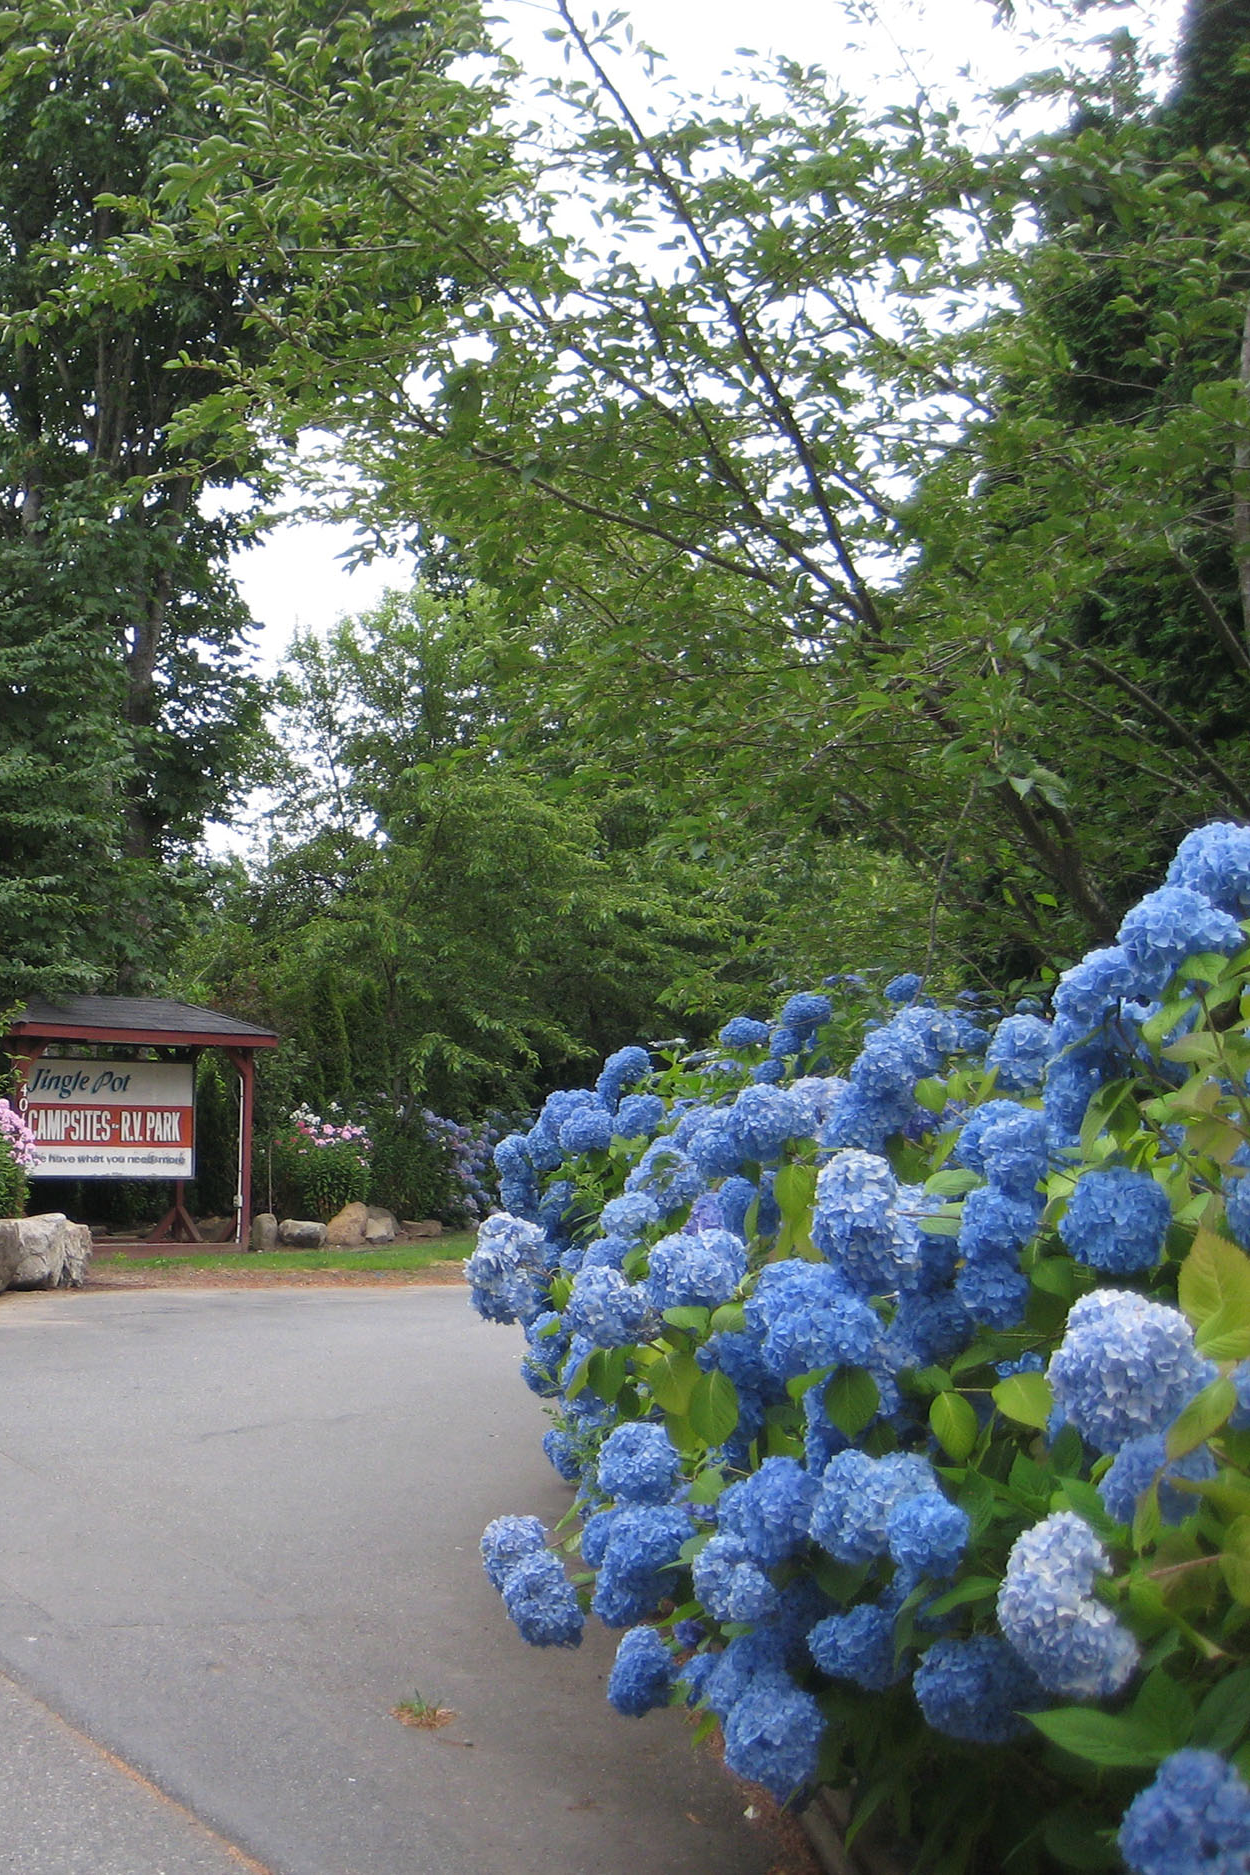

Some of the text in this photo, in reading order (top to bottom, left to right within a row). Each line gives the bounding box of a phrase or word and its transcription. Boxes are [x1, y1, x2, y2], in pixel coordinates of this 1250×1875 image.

[27, 1068, 132, 1099] Jingle Pot
[28, 1109, 111, 1141] CAMPSITES
[145, 1111, 181, 1142] PARK
[48, 1153, 76, 1164] have
[77, 1154, 104, 1164] what
[106, 1155, 125, 1165] you
